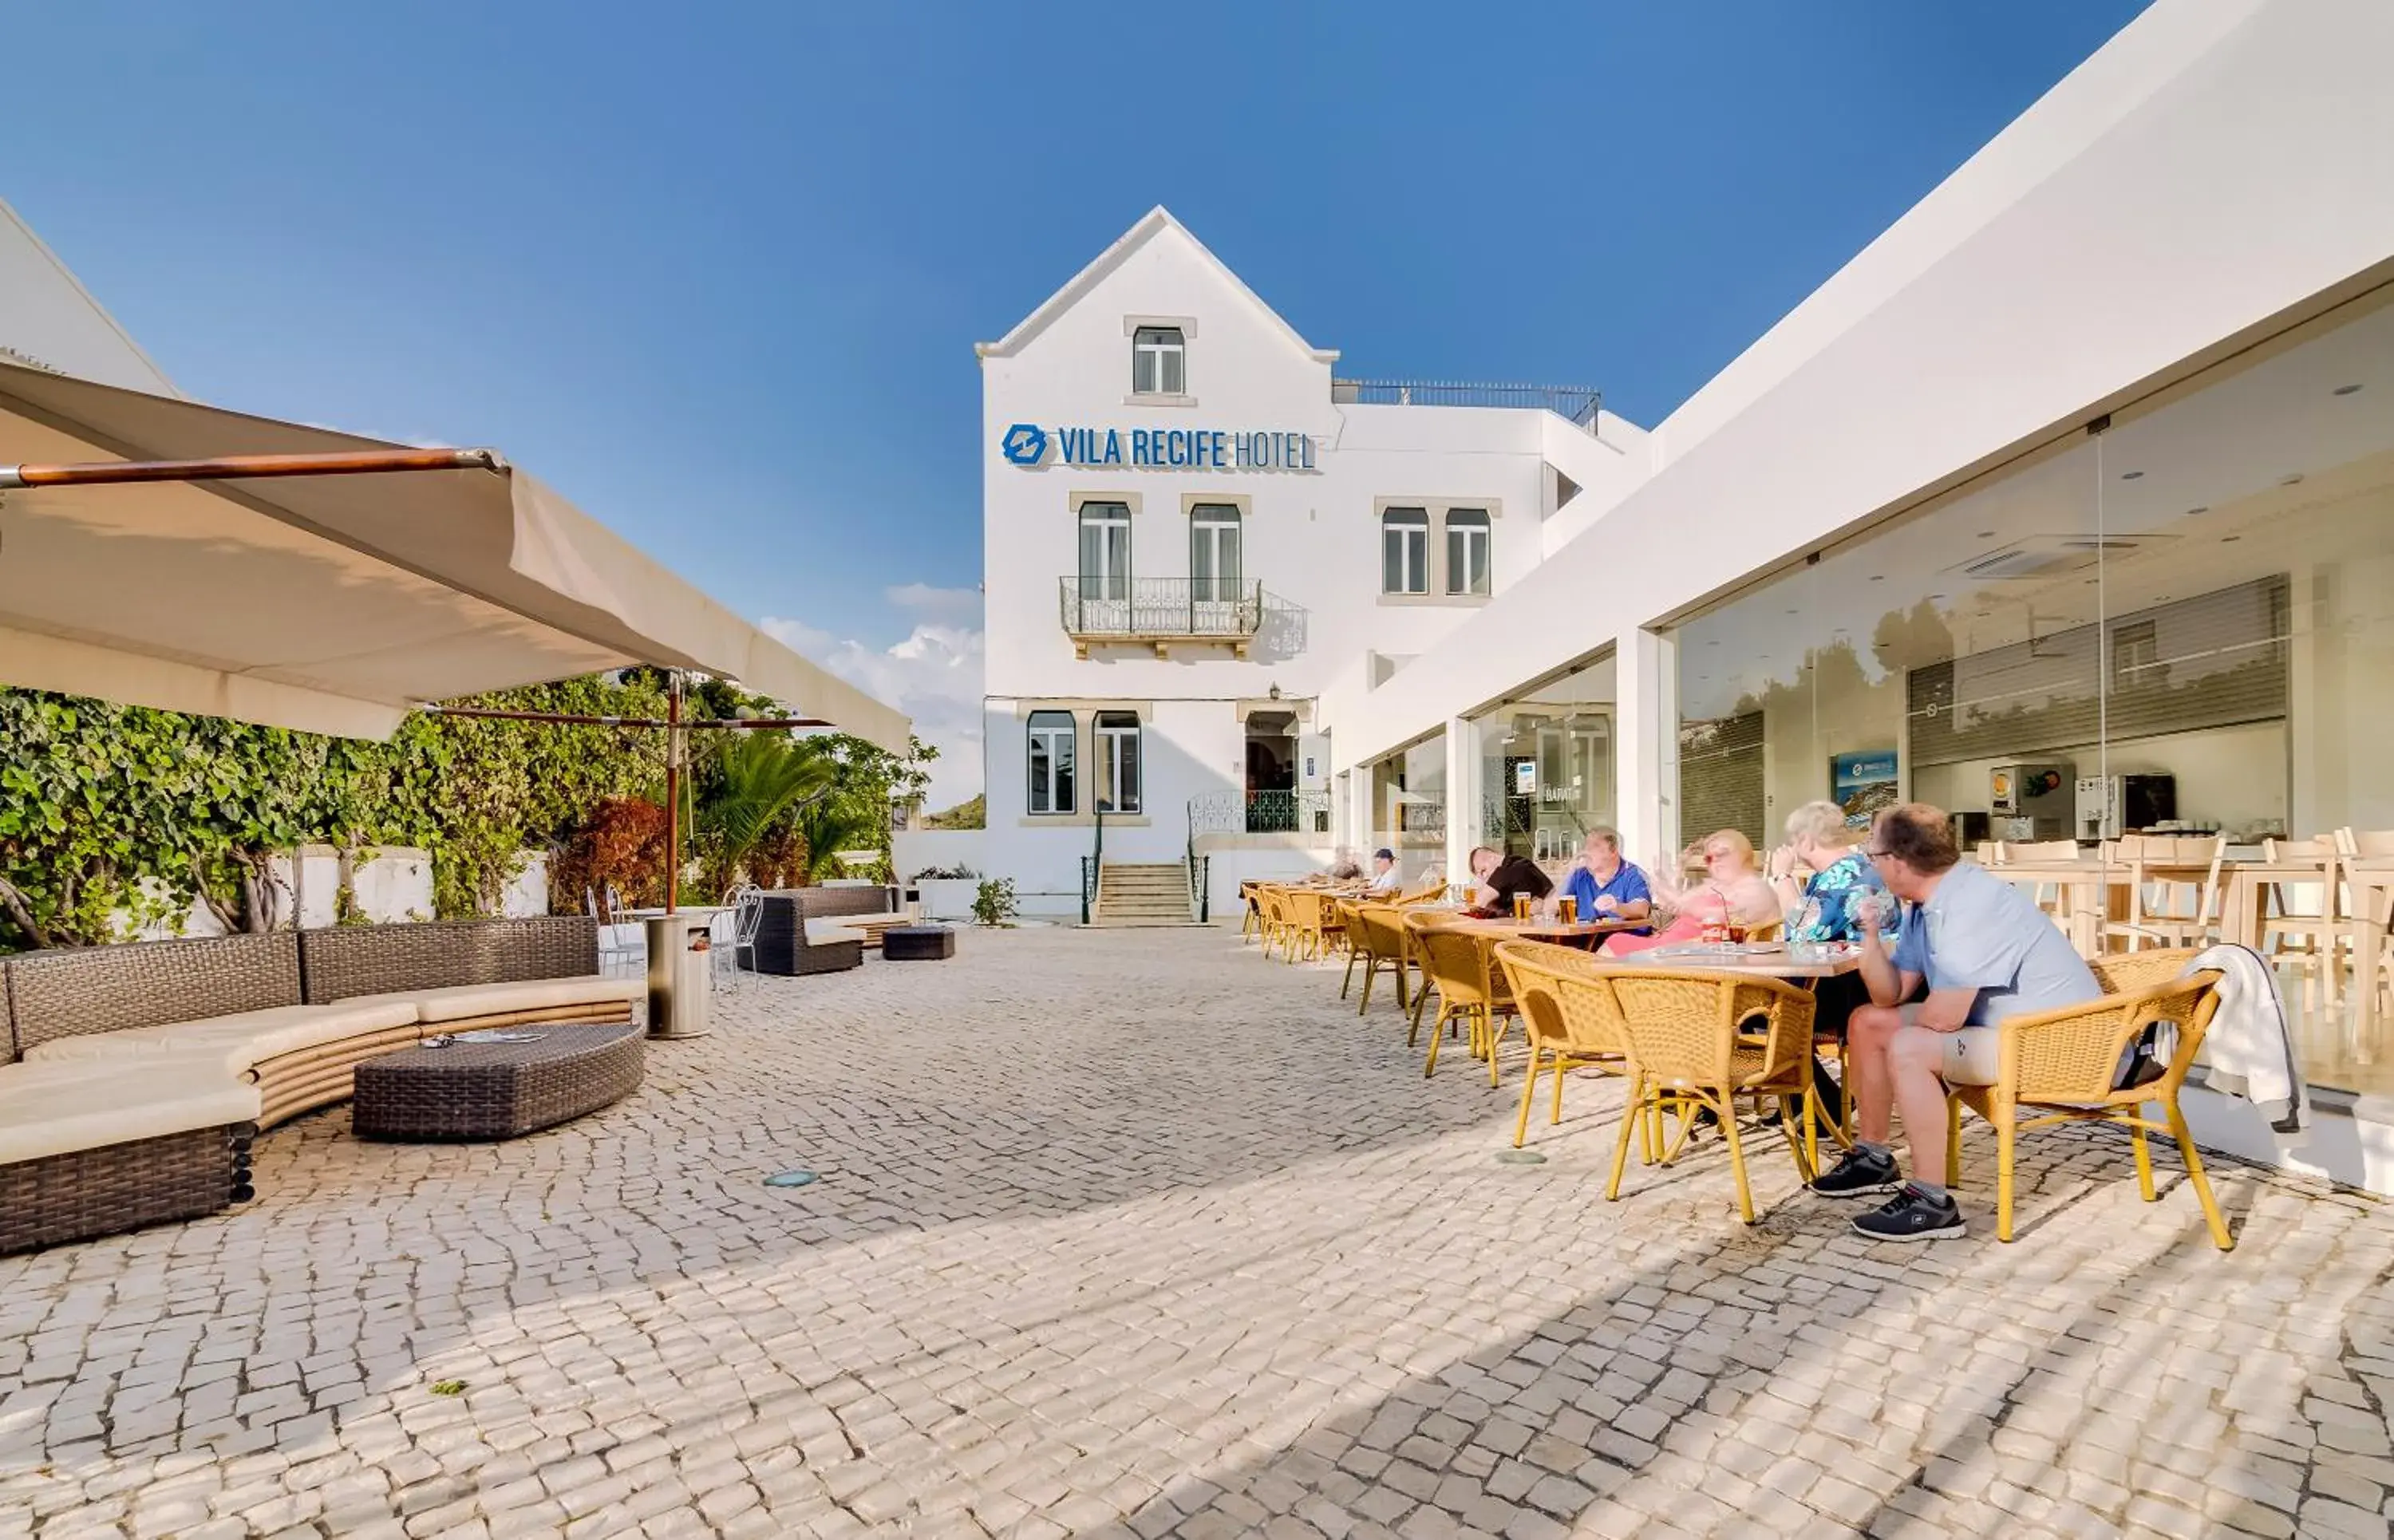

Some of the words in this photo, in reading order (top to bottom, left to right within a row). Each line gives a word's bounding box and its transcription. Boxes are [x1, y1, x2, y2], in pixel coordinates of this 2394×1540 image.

[1058, 428, 1120, 463] VILA
[1132, 429, 1226, 466] RECIFE
[1235, 432, 1314, 468] HOTEL
